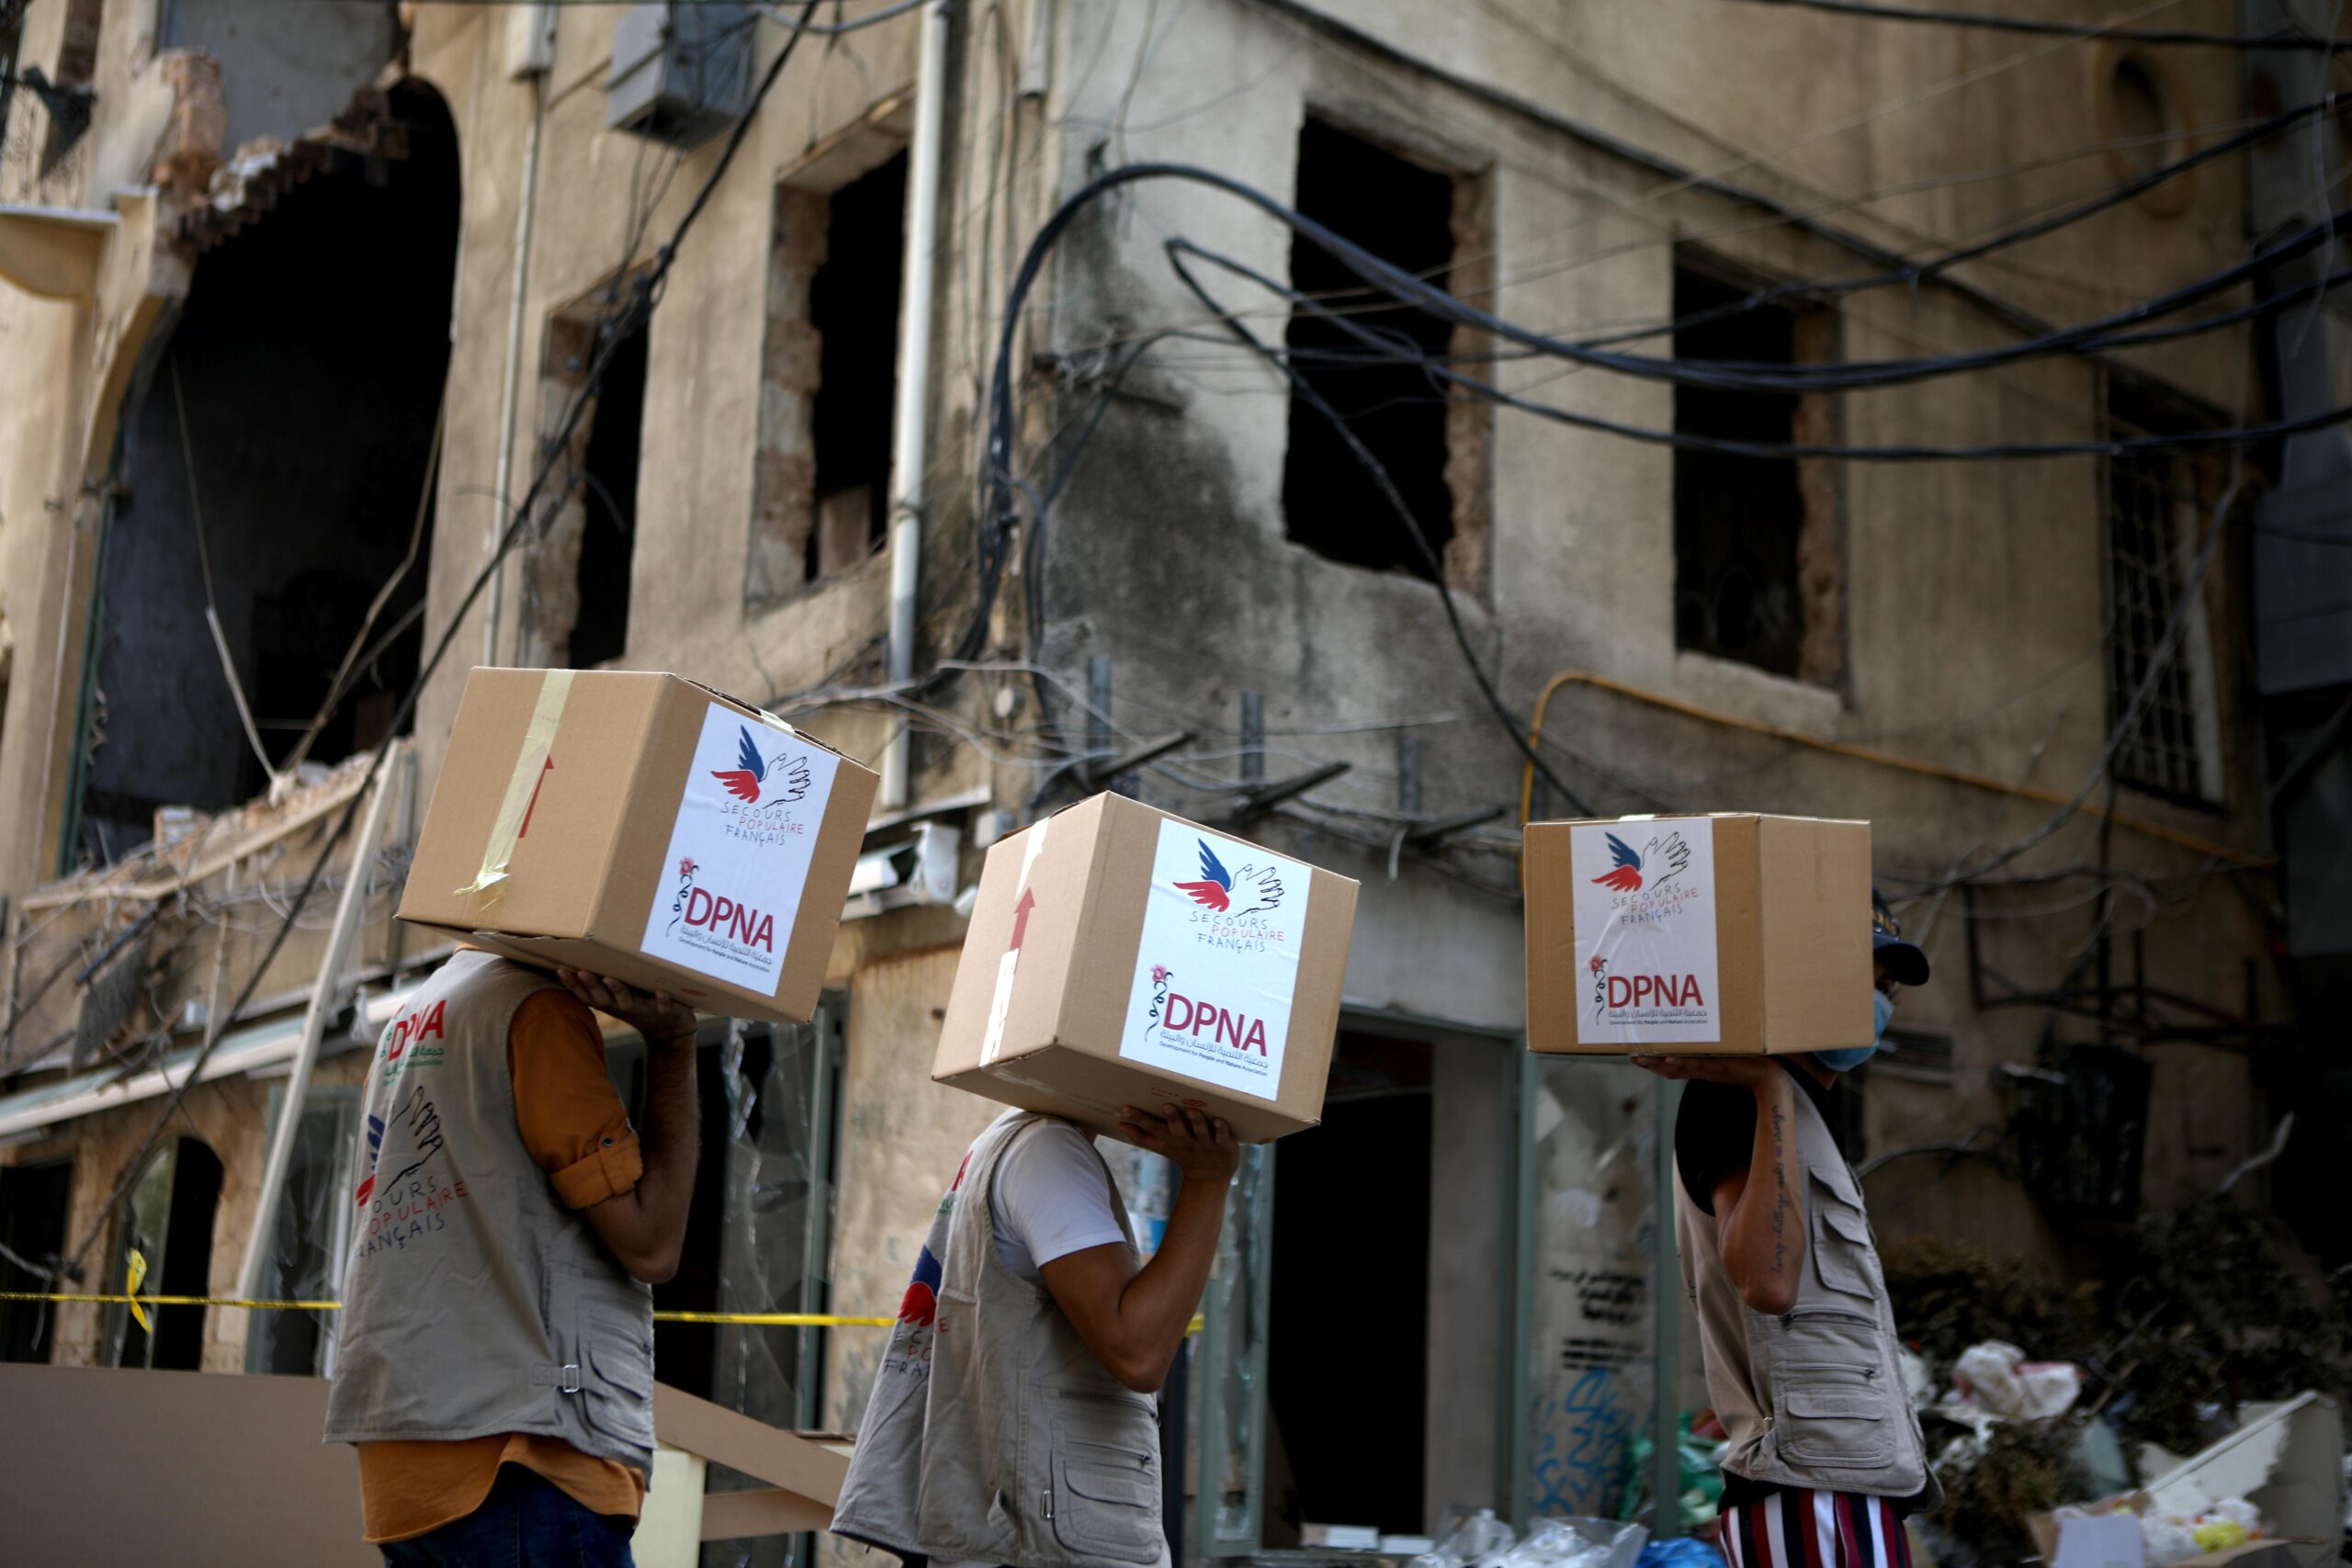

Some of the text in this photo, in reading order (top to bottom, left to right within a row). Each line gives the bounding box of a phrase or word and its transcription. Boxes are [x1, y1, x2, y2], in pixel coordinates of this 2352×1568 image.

[720, 800, 791, 823] SECOURS
[725, 824, 786, 847] FRANÇAIS
[739, 816, 806, 835] POPULAIRE
[1611, 882, 1681, 910] SECOURS
[1631, 887, 1699, 914] POPULAIRE
[684, 886, 774, 953] DPNA
[1188, 910, 1269, 931] SECOURS
[1621, 905, 1683, 926] FRANÇAIS
[1196, 933, 1265, 953] FRANÇAIS
[1211, 924, 1284, 942] POPULAIRE
[1607, 974, 1704, 1009] DPNA
[1162, 992, 1268, 1057] DPNA
[1198, 1052, 1215, 1062] People
[373, 1175, 437, 1213] OURS
[369, 1181, 469, 1235] OPULAIRE
